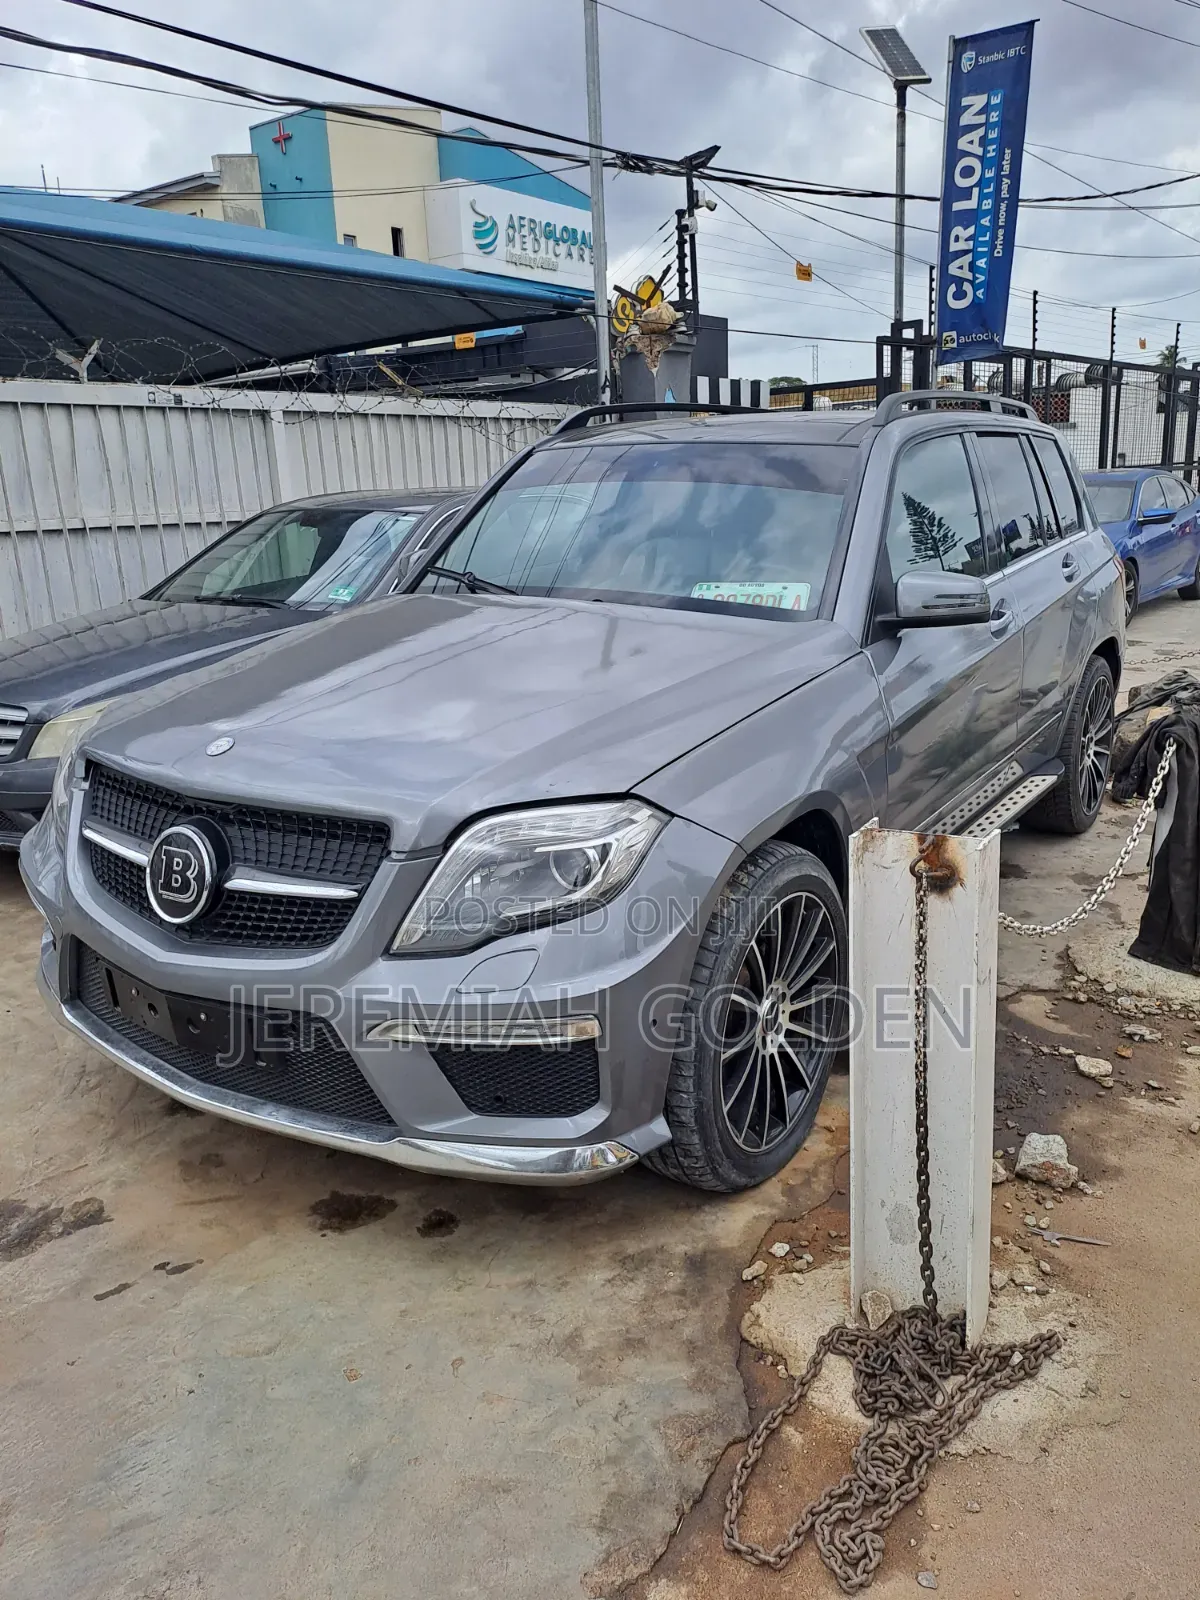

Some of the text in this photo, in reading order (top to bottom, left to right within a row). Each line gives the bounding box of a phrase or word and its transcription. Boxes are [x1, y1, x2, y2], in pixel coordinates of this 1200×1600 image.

[978, 45, 1026, 65] Stanbic IBTC
[947, 93, 988, 310] CAR LOAN
[976, 93, 1002, 299] AVAILABLE HERE
[994, 147, 1012, 257] Drive now, pay later
[505, 213, 593, 249] AFRIGLOBAL
[505, 230, 594, 265] MEDICARE
[159, 845, 199, 903] B
